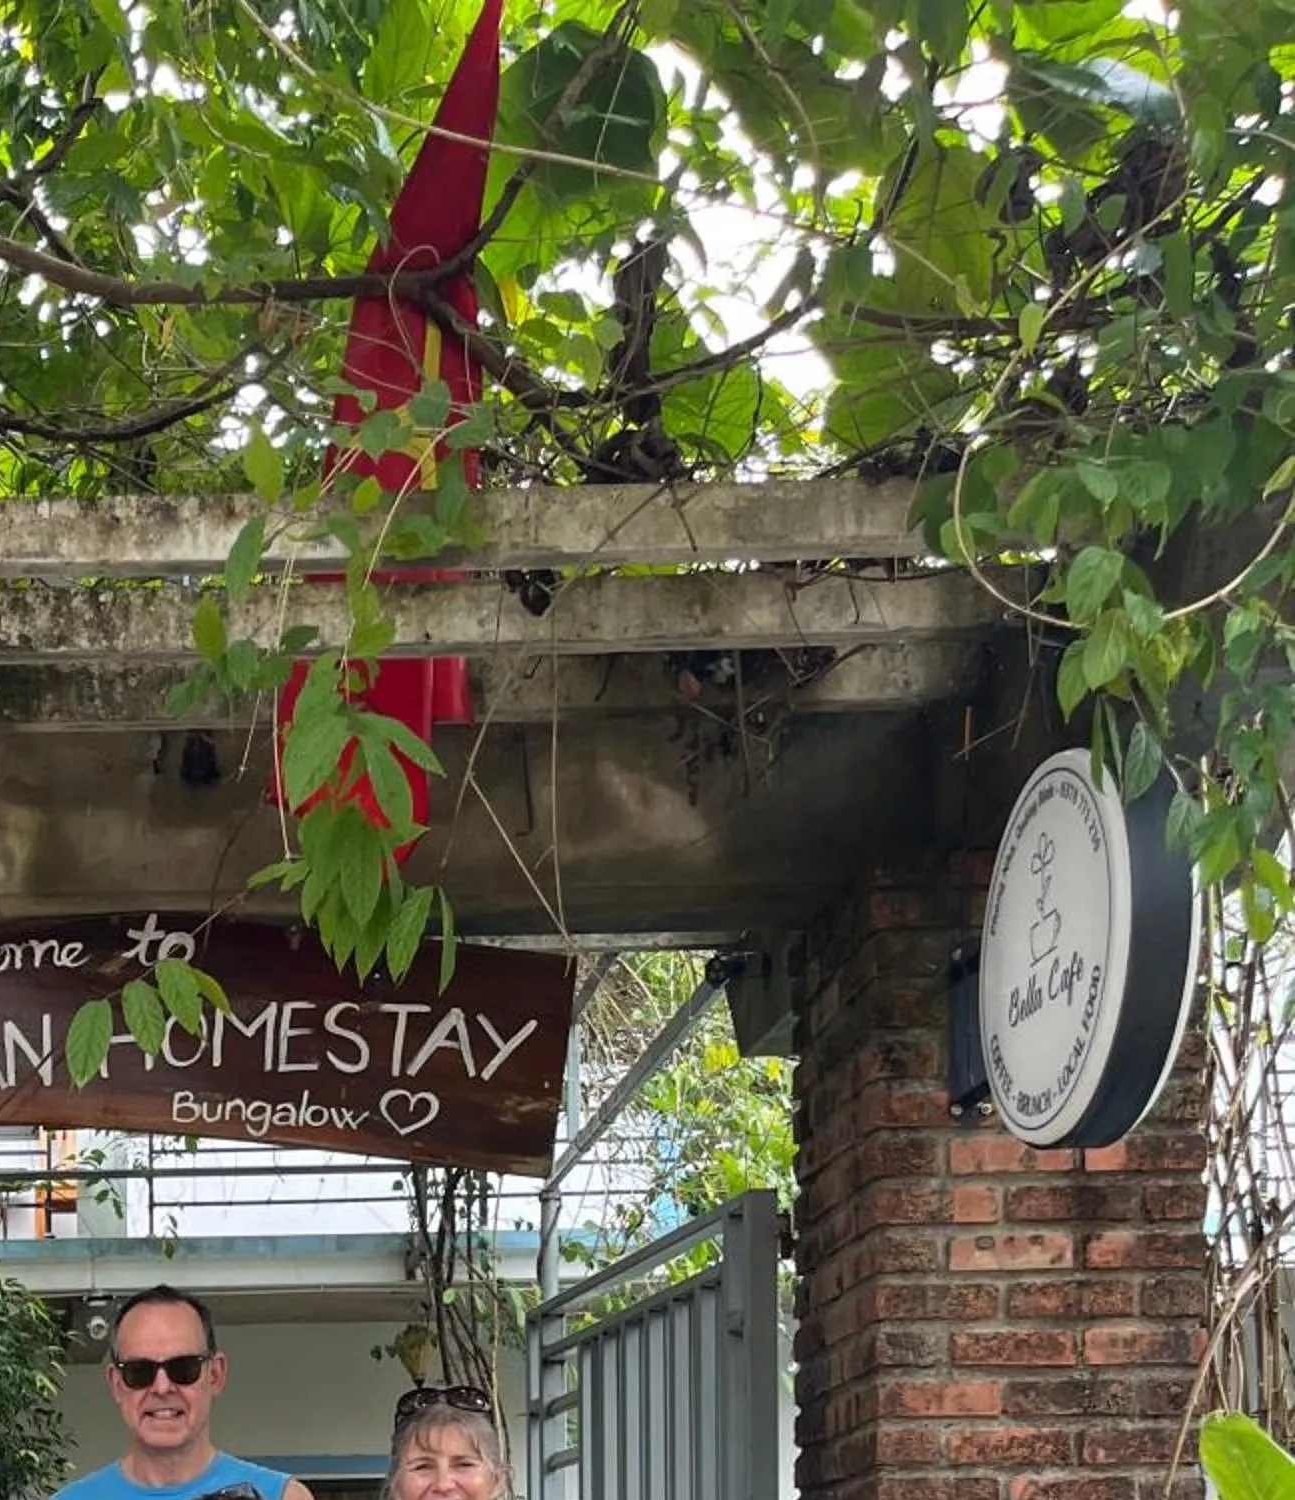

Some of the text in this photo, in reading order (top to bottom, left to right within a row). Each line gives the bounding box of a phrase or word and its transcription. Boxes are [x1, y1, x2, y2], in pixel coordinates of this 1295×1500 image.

[120, 912, 195, 967] to
[1008, 972, 1043, 1028] Bella
[1057, 1035, 1086, 1096] LOCAL
[1081, 963, 1101, 1033] FOOD
[171, 1090, 370, 1137] Bungalow
